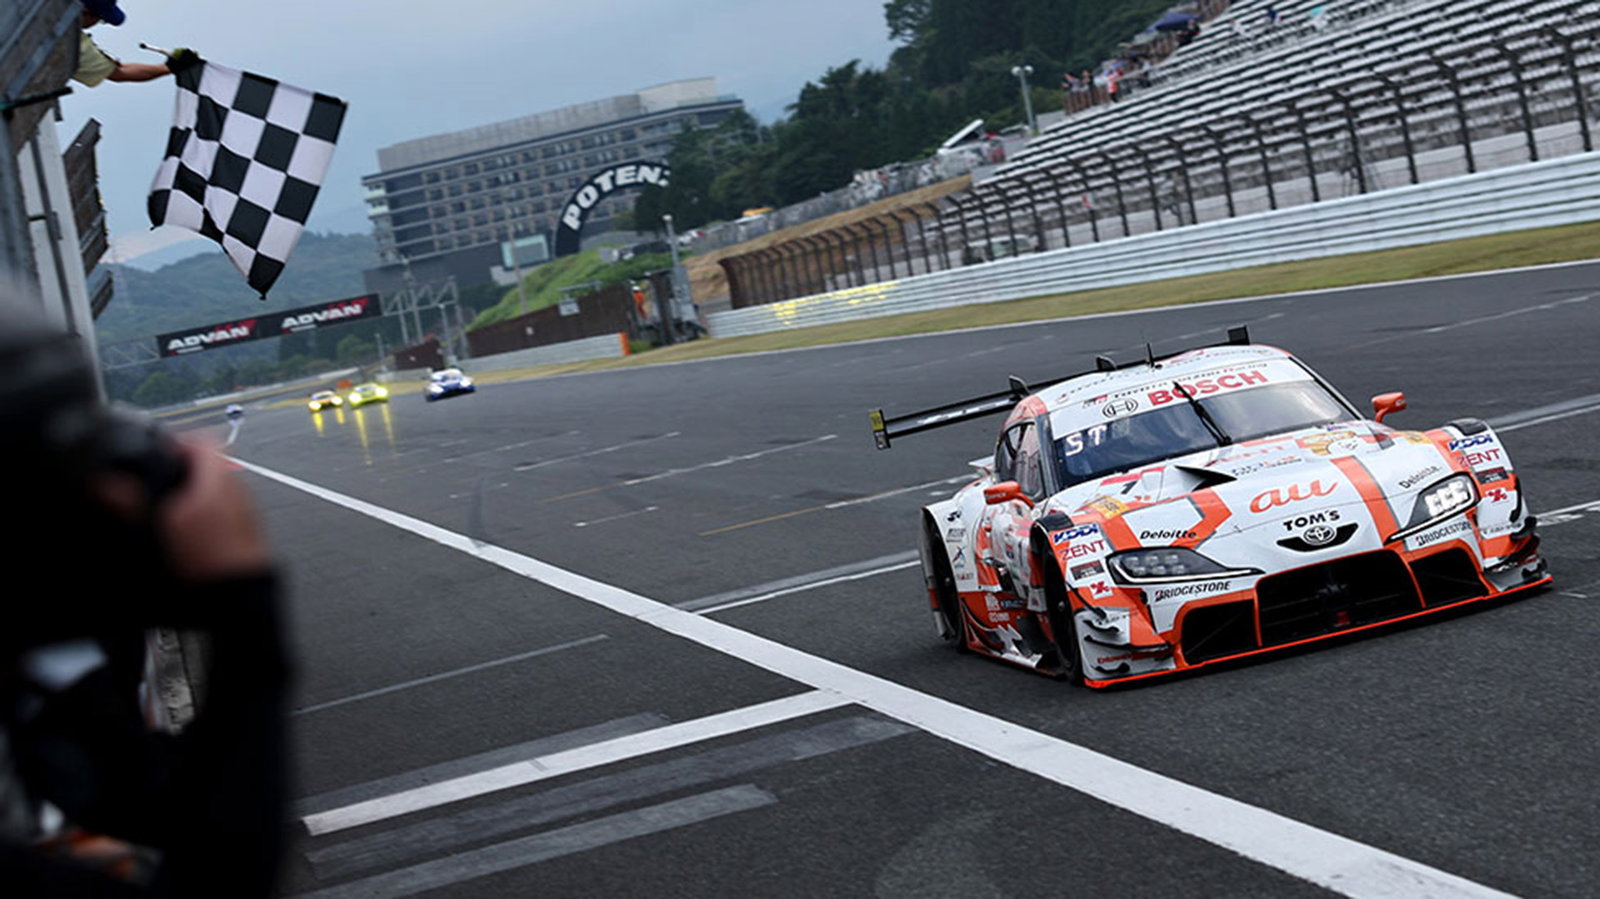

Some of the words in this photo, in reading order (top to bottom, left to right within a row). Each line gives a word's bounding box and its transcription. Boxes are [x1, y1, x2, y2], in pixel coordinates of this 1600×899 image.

[281, 304, 363, 329] ADVAN
[168, 325, 250, 350] ADVAN
[1148, 371, 1269, 406] BOSCH
[1449, 434, 1494, 451] KDDI
[1457, 448, 1500, 467] ZENT
[1250, 480, 1338, 513] au
[1283, 510, 1340, 531] TOM'S
[1053, 523, 1099, 545] KDDI
[1140, 529, 1197, 540] Deloitte
[1059, 540, 1106, 562] ZENT
[1155, 581, 1232, 603] BRIDGESTONE
